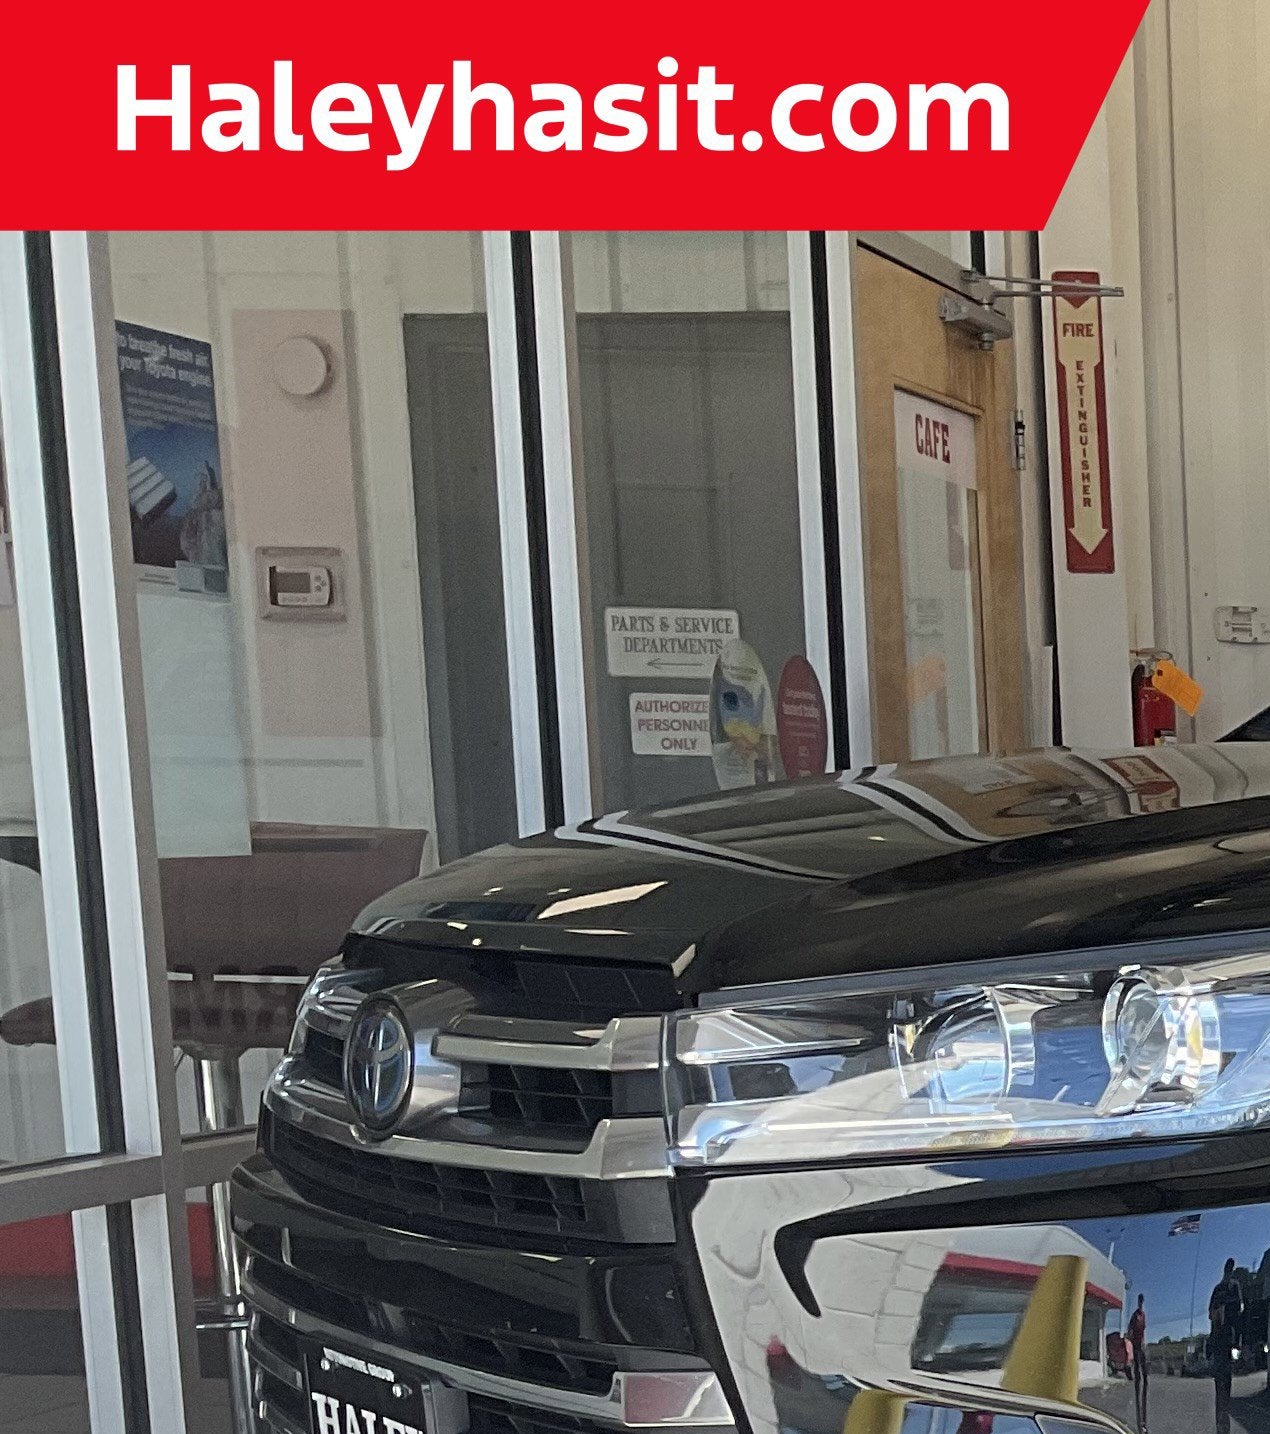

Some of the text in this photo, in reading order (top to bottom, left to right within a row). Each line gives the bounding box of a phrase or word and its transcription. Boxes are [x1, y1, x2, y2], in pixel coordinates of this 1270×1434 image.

[1062, 322, 1094, 338] FIRE
[914, 413, 951, 464] CAFE
[1075, 360, 1092, 508] EXTINGUISHER
[610, 615, 734, 634] PARTS & SERVICE
[623, 636, 724, 655] DEPARTMENTS
[634, 700, 709, 714] AUTHORIZE
[661, 737, 698, 751] ONLY
